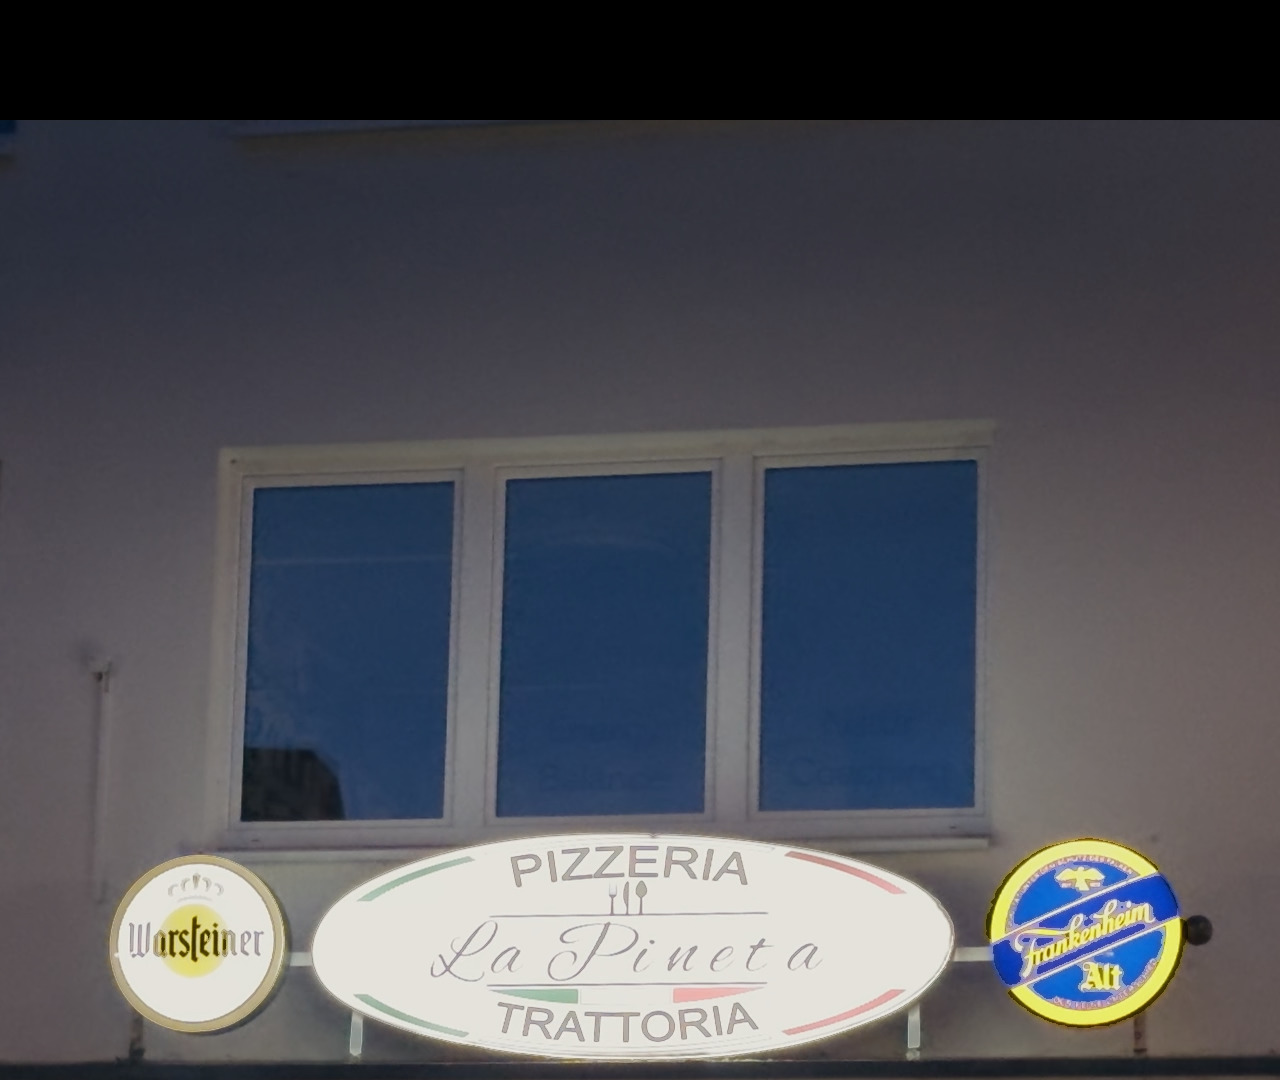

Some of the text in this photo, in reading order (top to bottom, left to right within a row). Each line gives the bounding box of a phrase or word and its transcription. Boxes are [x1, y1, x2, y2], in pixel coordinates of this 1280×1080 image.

[510, 845, 748, 888] PIZZERIA
[129, 915, 264, 962] Warsteiner
[430, 920, 823, 982] La Pineta
[1014, 899, 1156, 978] Frankenheim
[1081, 962, 1123, 992] Alt
[497, 1001, 759, 1043] TRATTORIA
